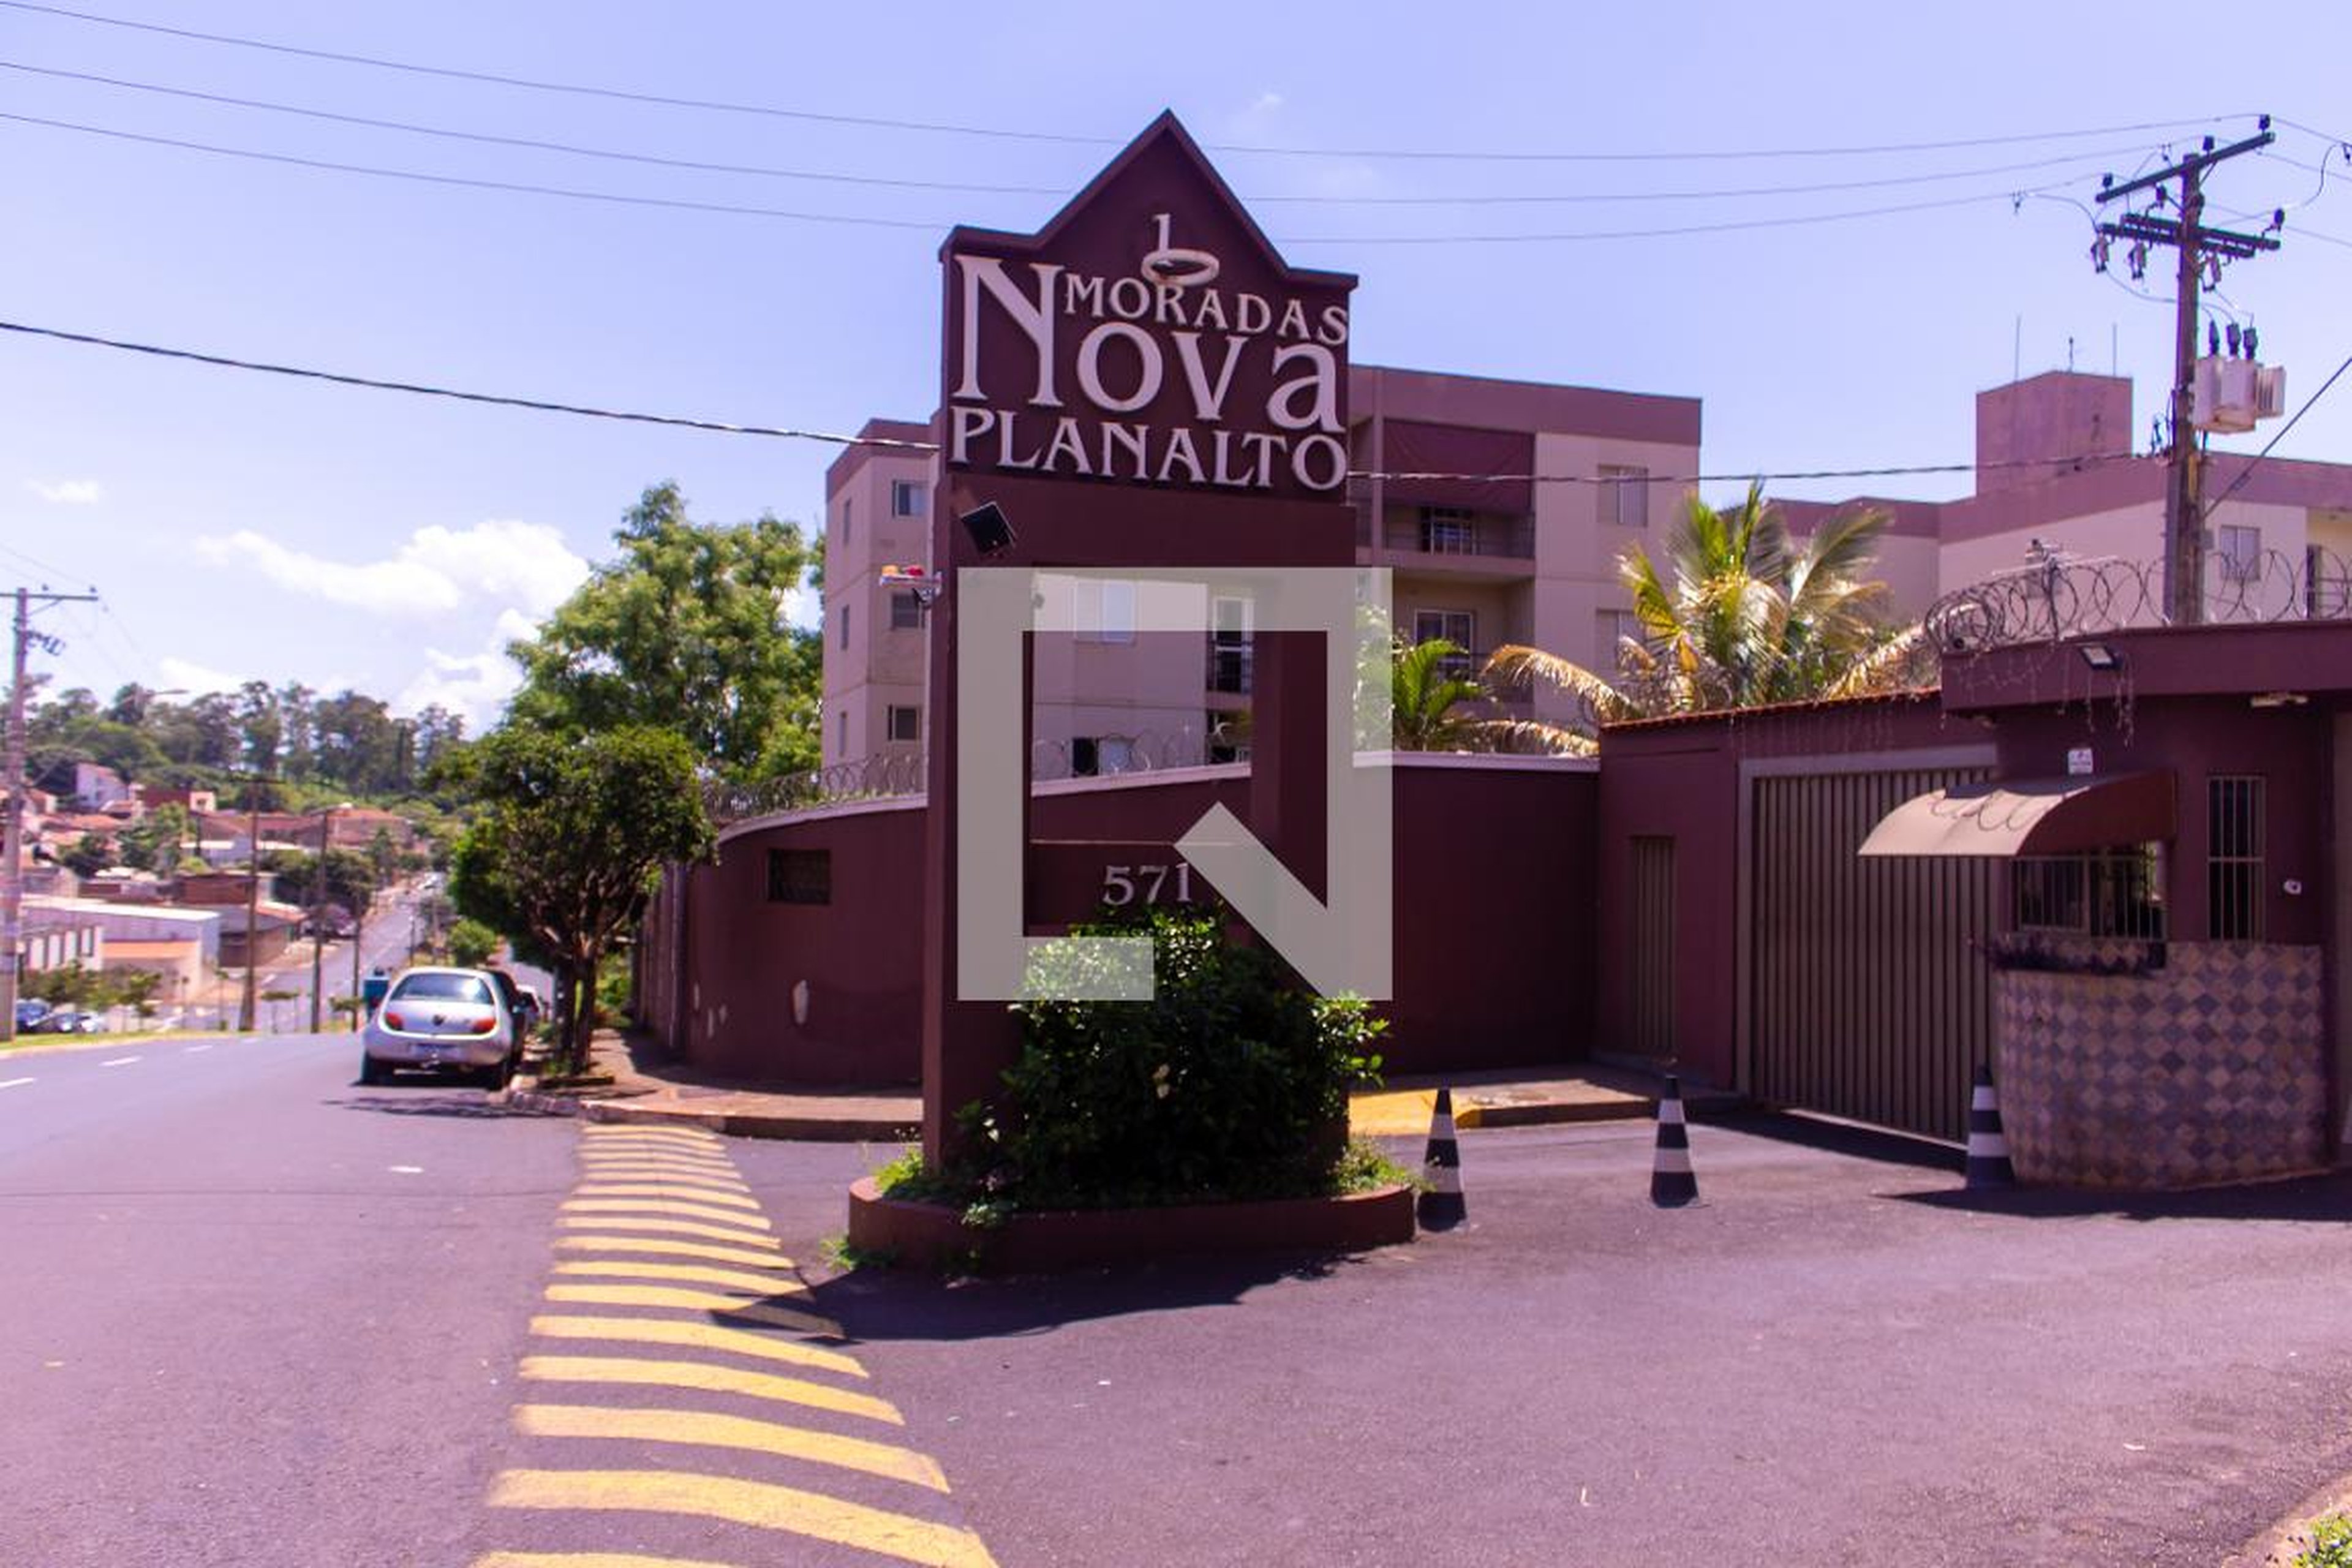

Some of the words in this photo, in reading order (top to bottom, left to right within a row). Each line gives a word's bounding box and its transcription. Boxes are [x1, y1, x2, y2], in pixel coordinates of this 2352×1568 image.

[1063, 273, 1349, 345] MORADAS
[949, 405, 1348, 491] PLANALTO
[1102, 862, 1192, 905] 571
